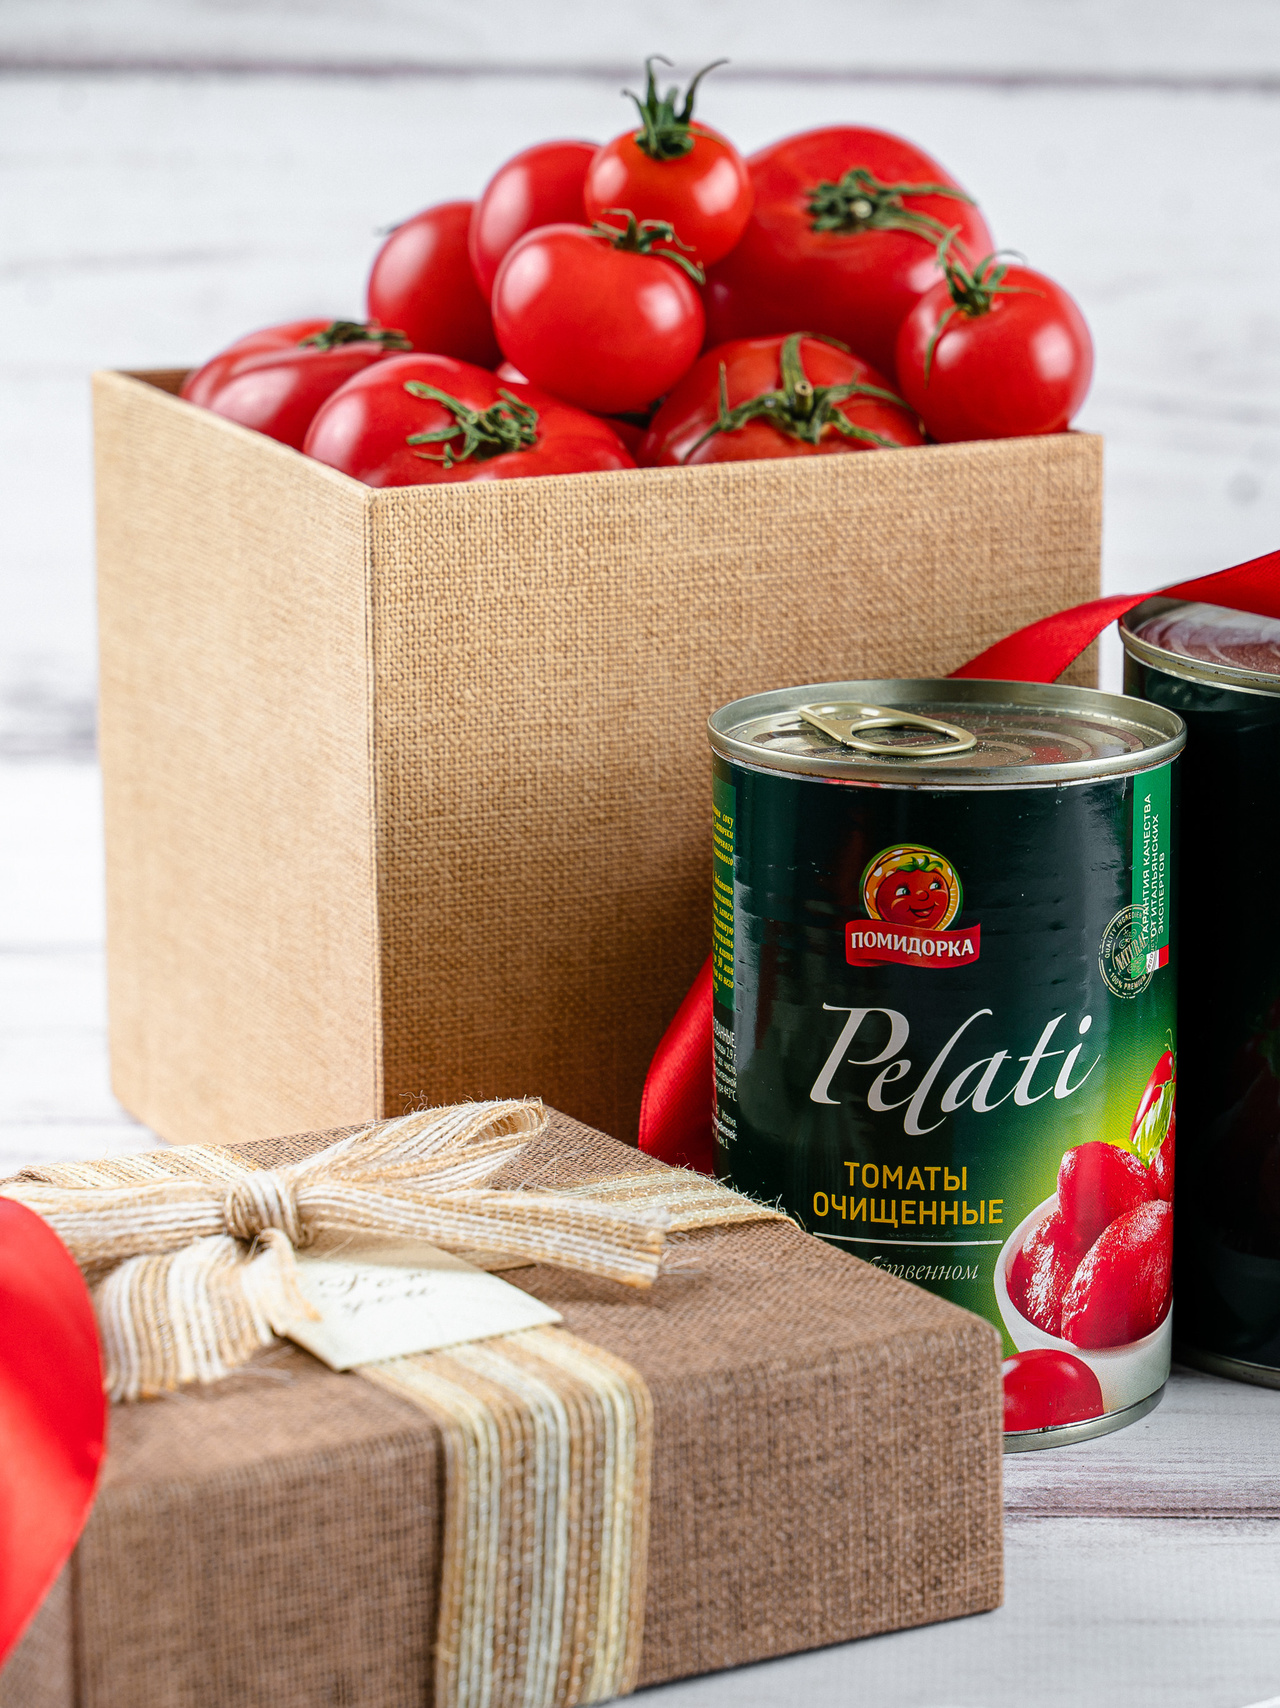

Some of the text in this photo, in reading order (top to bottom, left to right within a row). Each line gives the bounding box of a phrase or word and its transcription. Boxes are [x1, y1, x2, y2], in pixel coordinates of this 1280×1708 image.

[1142, 793, 1152, 941] ГАРАНТИЯ КАЧЕСТВА
[1150, 813, 1160, 937] ОТ ИТАЛЬЯНСКИХ
[850, 931, 975, 958] ПОМИДОРКА
[1104, 928, 1117, 959] QUALITY
[1115, 932, 1150, 971] NATURAL
[1110, 972, 1148, 991] 100% PREMIUM
[809, 1003, 1101, 1136] Pelati
[844, 1161, 967, 1191] ТОМАТЫ
[813, 1190, 1003, 1229] ОЧИЩЕННЫЕ
